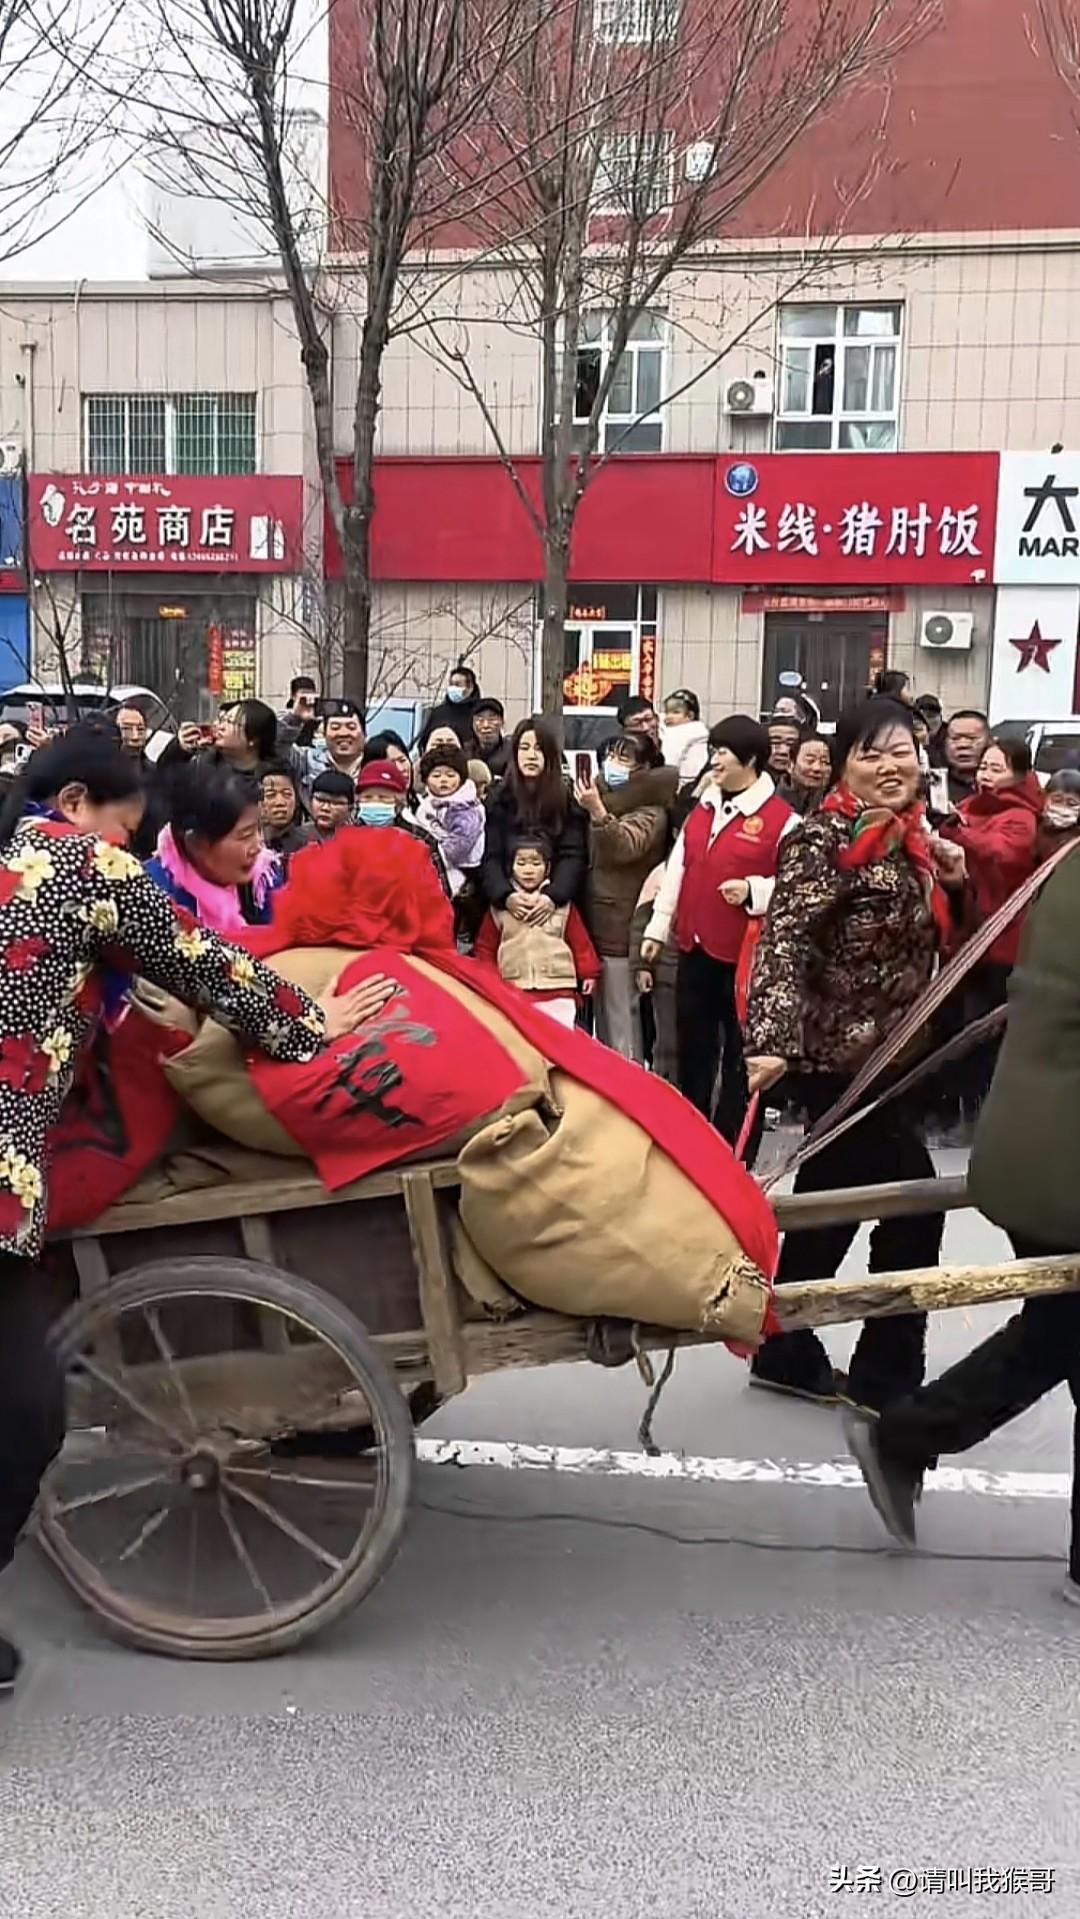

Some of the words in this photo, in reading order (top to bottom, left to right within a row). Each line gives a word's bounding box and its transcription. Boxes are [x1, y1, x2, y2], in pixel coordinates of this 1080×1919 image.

[64, 502, 235, 546] 名苑商店
[730, 501, 984, 557] 米线·猪肘饭
